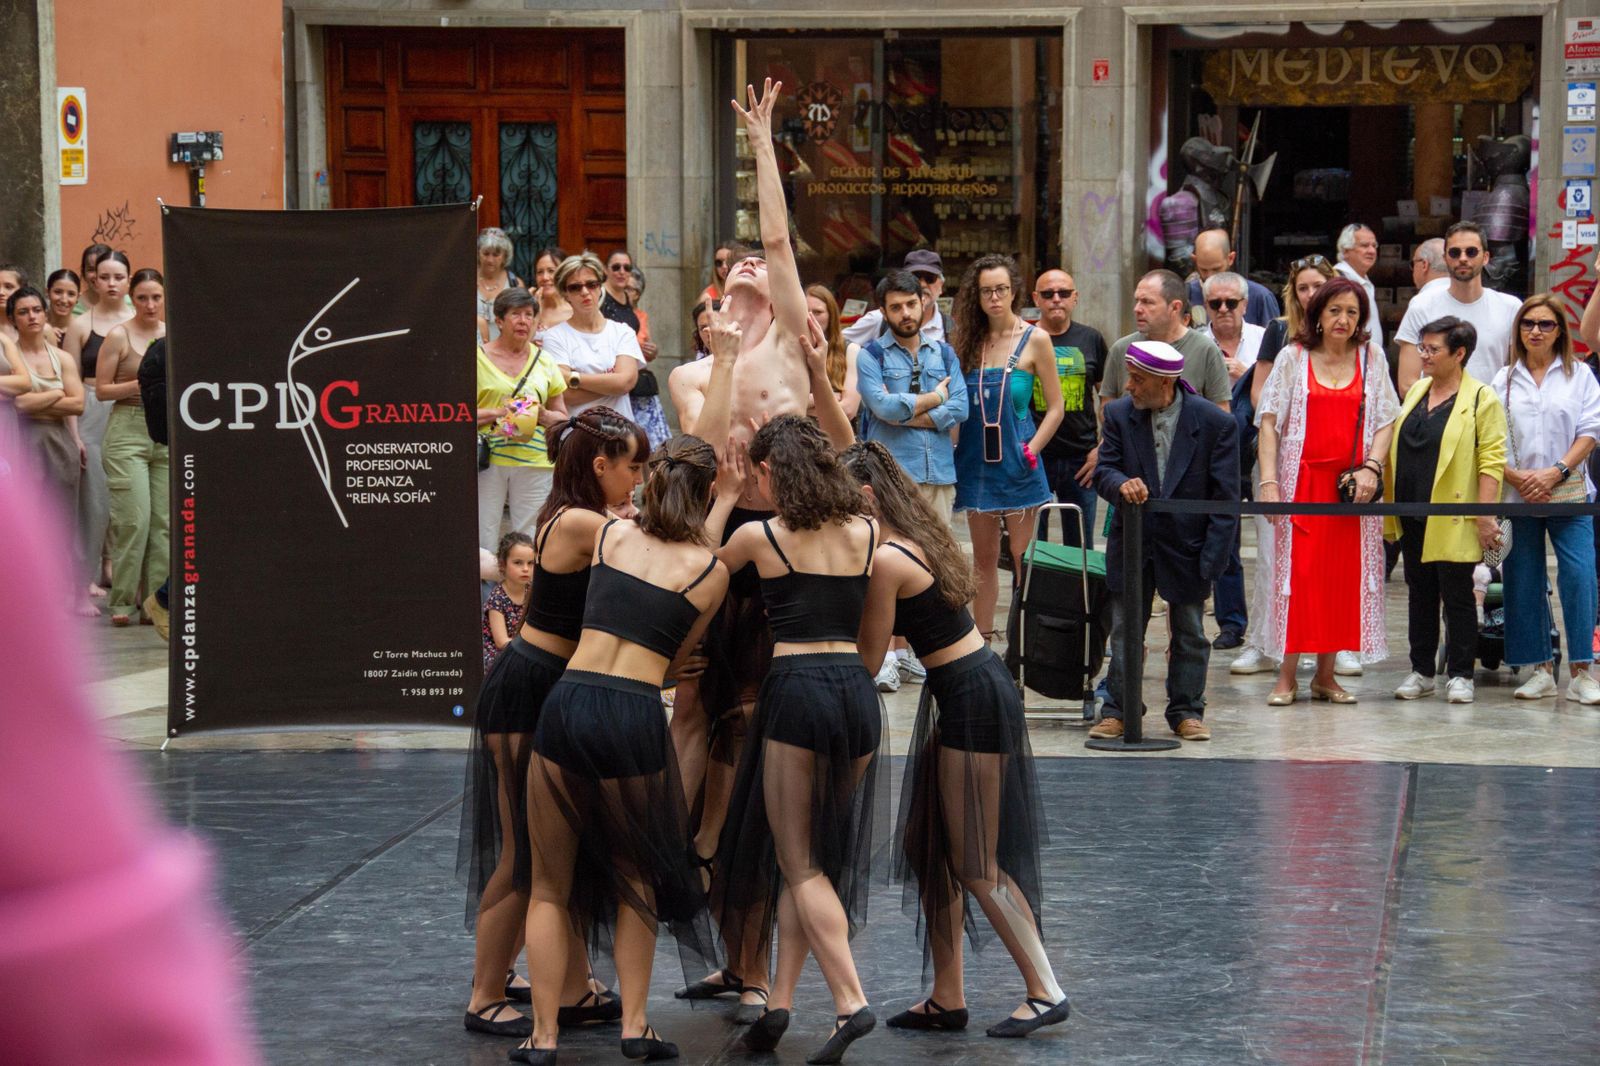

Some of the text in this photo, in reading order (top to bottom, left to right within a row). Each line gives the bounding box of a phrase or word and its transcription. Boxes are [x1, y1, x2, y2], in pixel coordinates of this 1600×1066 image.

[1228, 44, 1504, 96] MEDIEVO
[883, 165, 900, 178] DE
[807, 182, 887, 197] PRODUCTOS
[345, 442, 453, 455] CONSERVATORIO
[346, 458, 432, 471] PROFESIONAL
[346, 475, 413, 488] DE DANZA
[182, 453, 199, 721] www.cpdanzagranada.com
[373, 649, 463, 659] C/ Torre Machuca s/n
[363, 669, 389, 678] 18007
[421, 668, 463, 679] (Granada)
[401, 687, 463, 696] T. 958 893 189
